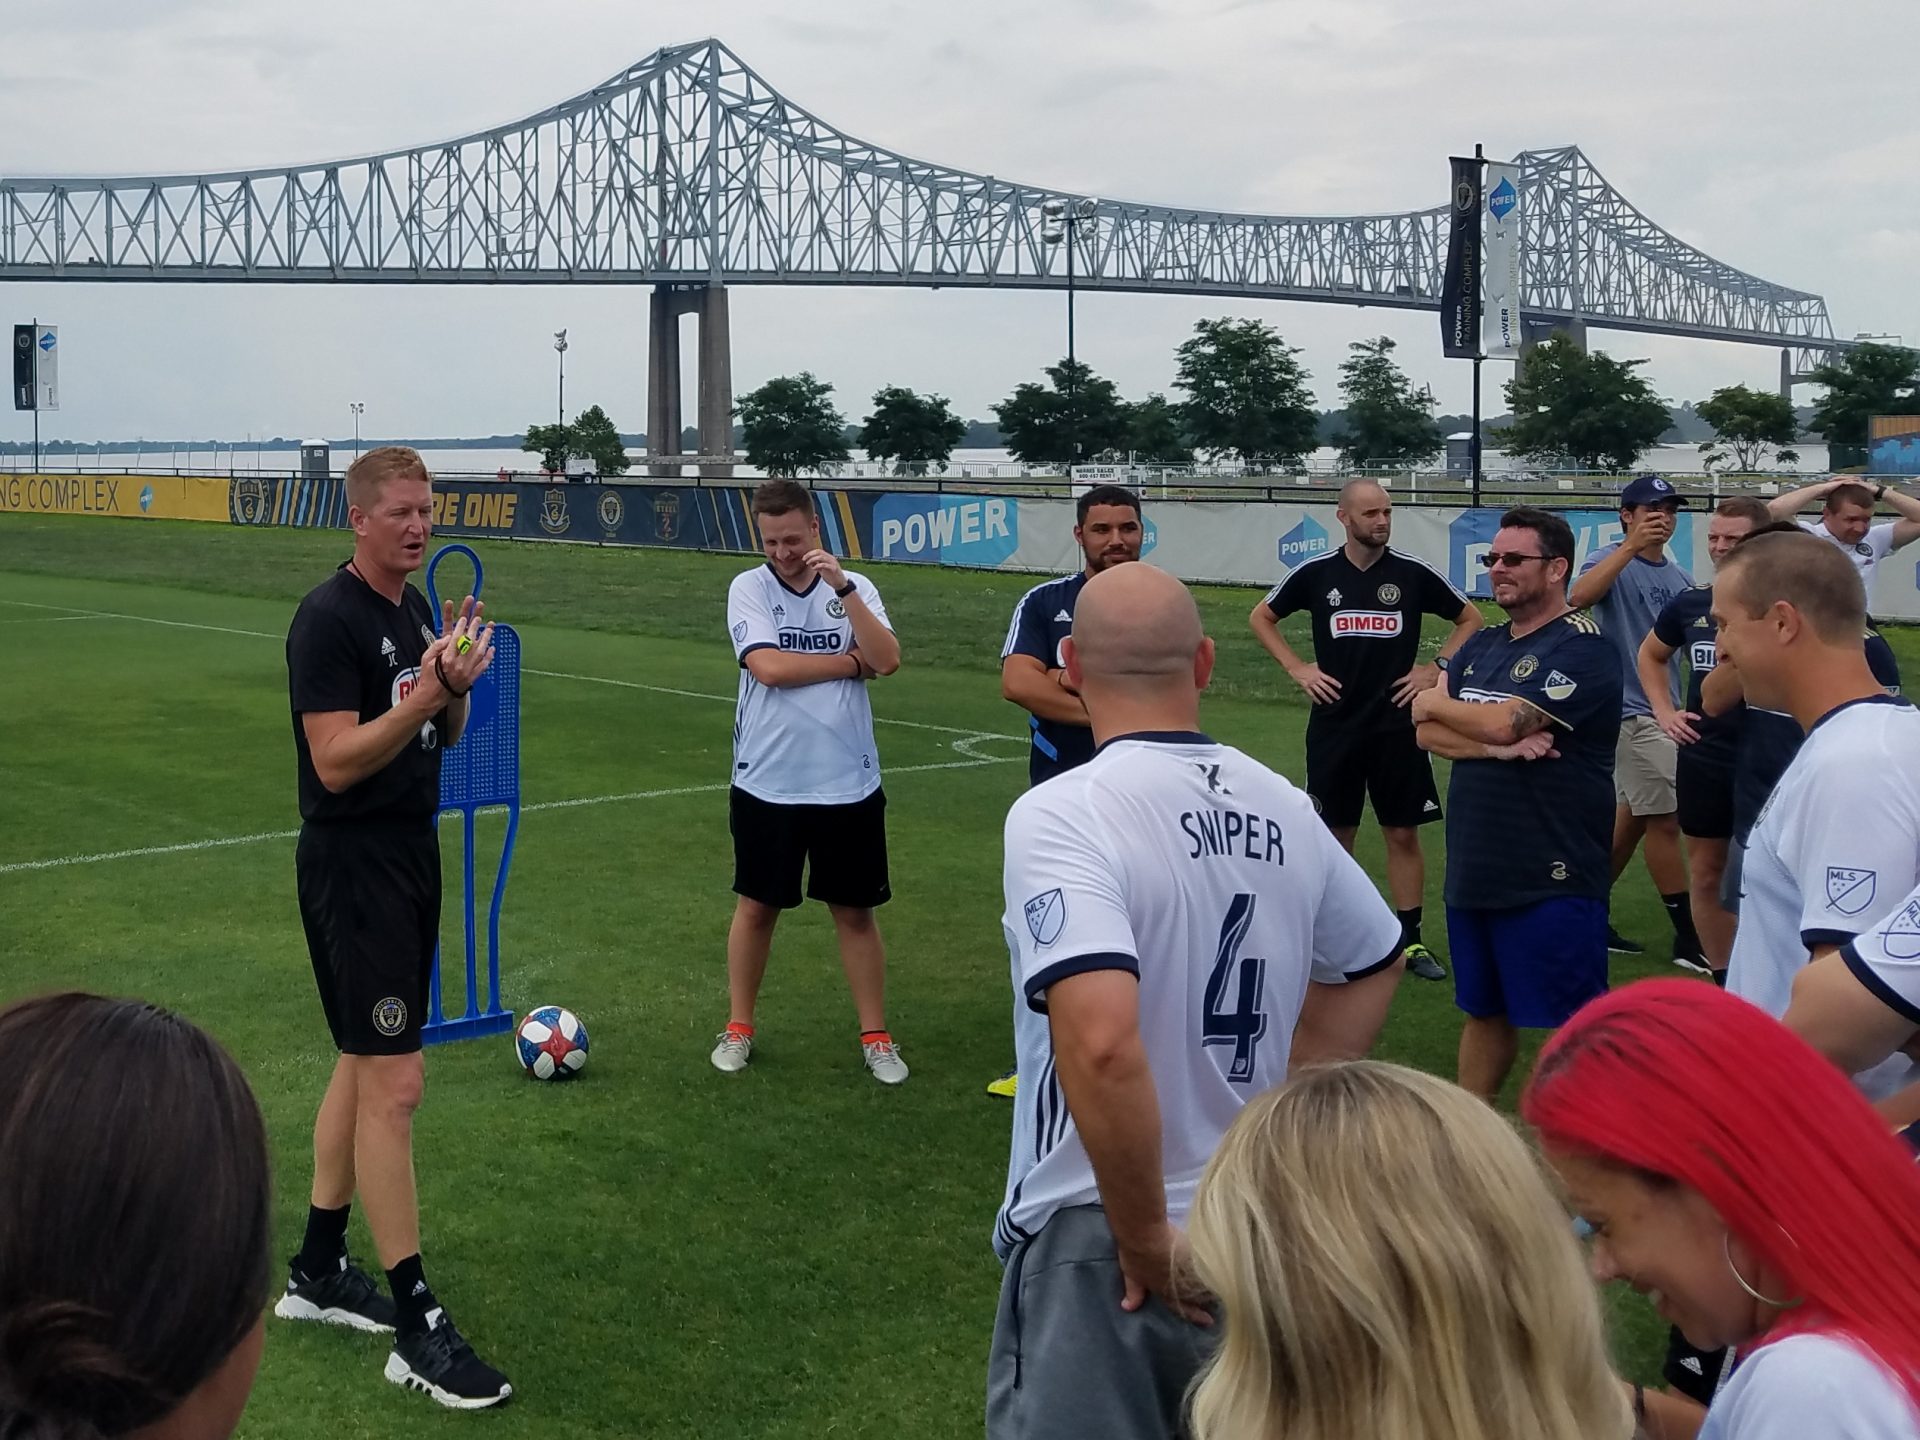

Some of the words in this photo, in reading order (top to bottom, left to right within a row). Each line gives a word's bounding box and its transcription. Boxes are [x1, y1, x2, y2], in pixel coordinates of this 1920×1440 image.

[1491, 194, 1515, 206] POWER
[1455, 304, 1463, 347] POWER
[1501, 308, 1511, 347] POWER
[27, 479, 119, 511] COMPLEX
[464, 493, 518, 528] ONE
[882, 499, 1010, 558] POWER
[1281, 538, 1326, 556] POWER
[1335, 616, 1398, 632] BIMBO
[778, 632, 841, 651] BIMBO
[1694, 648, 1717, 666] BI
[1179, 810, 1286, 867] SNIPER
[1830, 870, 1857, 882] MLS
[1026, 897, 1046, 917] MLS
[1201, 892, 1268, 1084] 4
